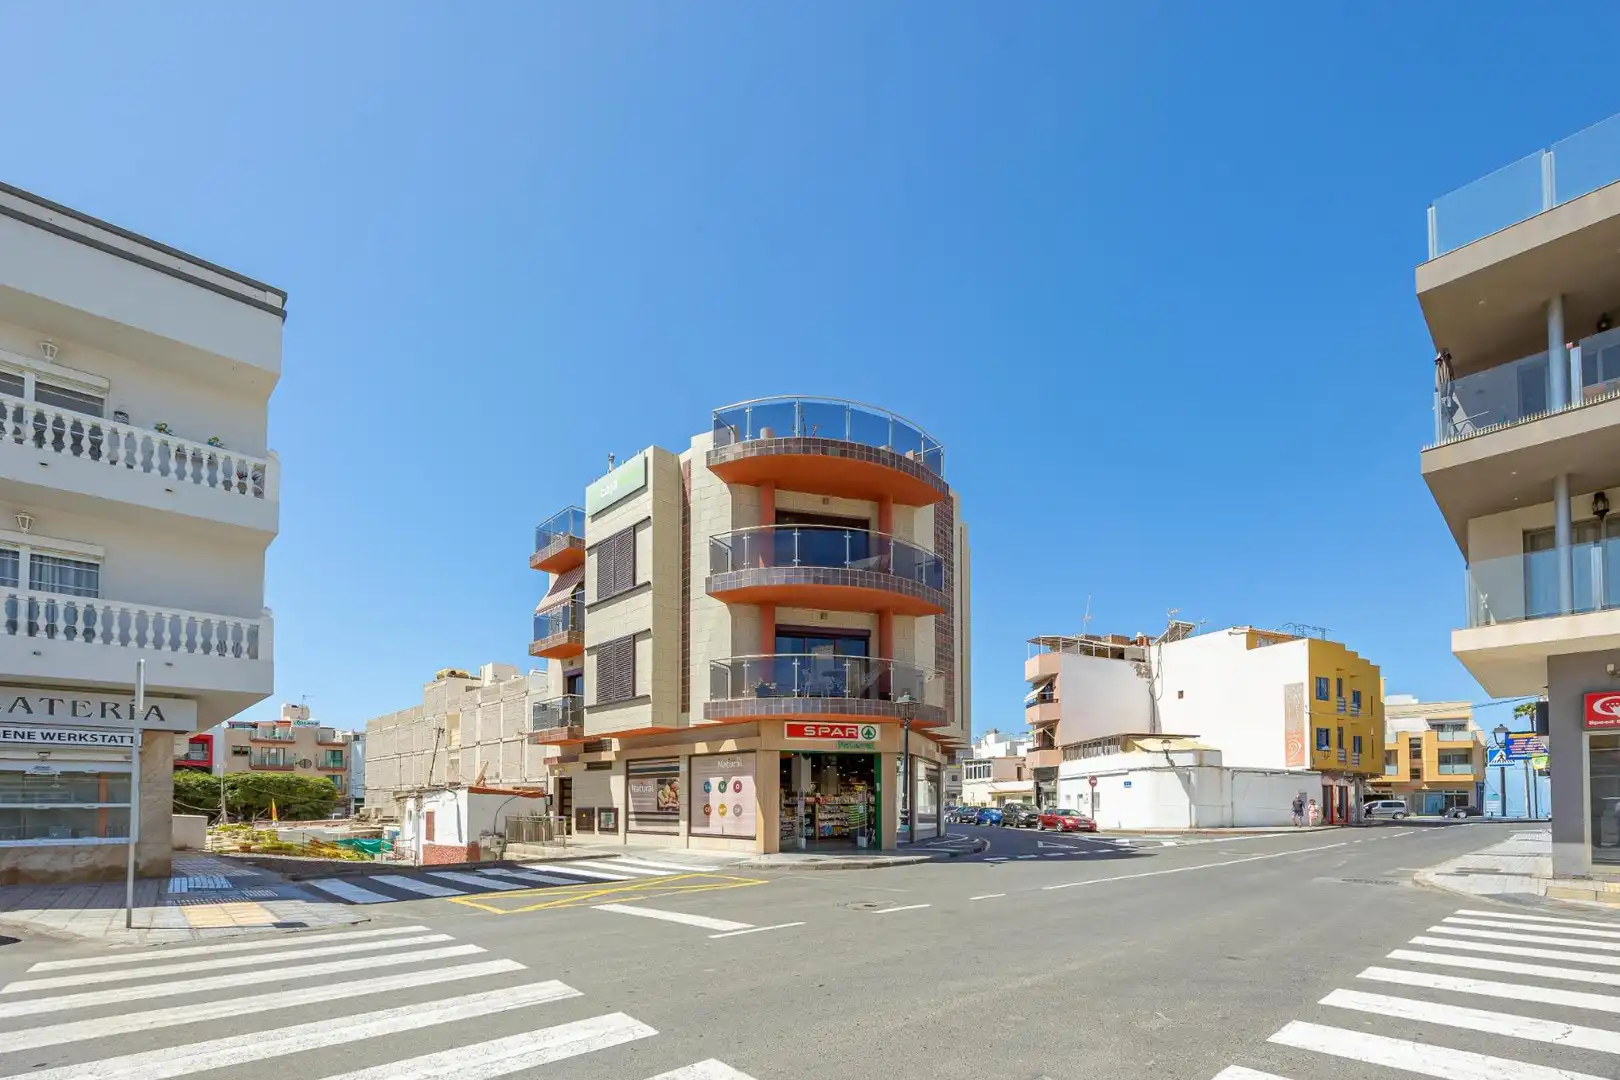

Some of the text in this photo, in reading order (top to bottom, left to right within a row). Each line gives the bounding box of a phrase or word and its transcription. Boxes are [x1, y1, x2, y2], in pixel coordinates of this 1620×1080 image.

[0, 696, 166, 722] ATERÍA
[0, 729, 134, 744] ENE WERKSTATT
[803, 725, 858, 737] SPAR
[717, 756, 743, 769] Natural
[631, 783, 654, 793] Natural
